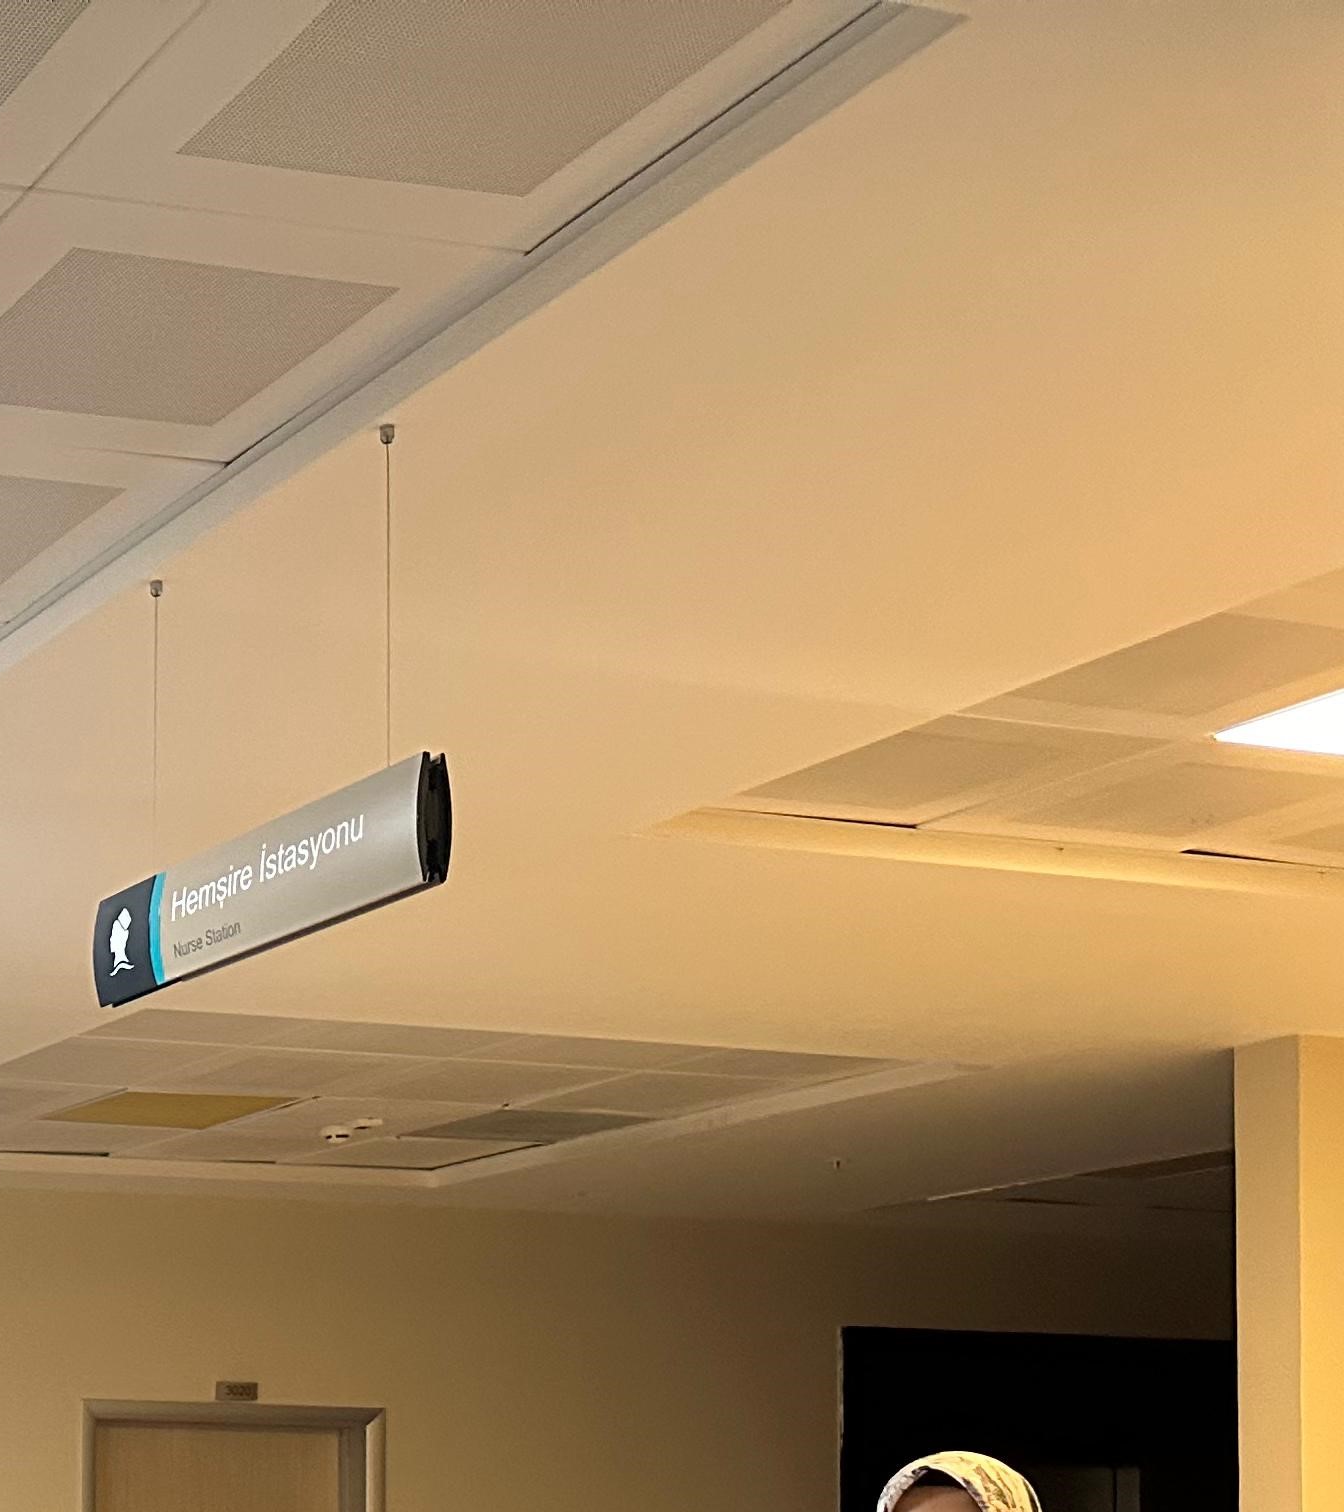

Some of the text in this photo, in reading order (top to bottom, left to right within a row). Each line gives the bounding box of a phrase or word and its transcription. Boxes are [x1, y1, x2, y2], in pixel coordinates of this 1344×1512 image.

[171, 814, 364, 921] Hemşire İstasyonu
[173, 920, 241, 958] Nurse Station
